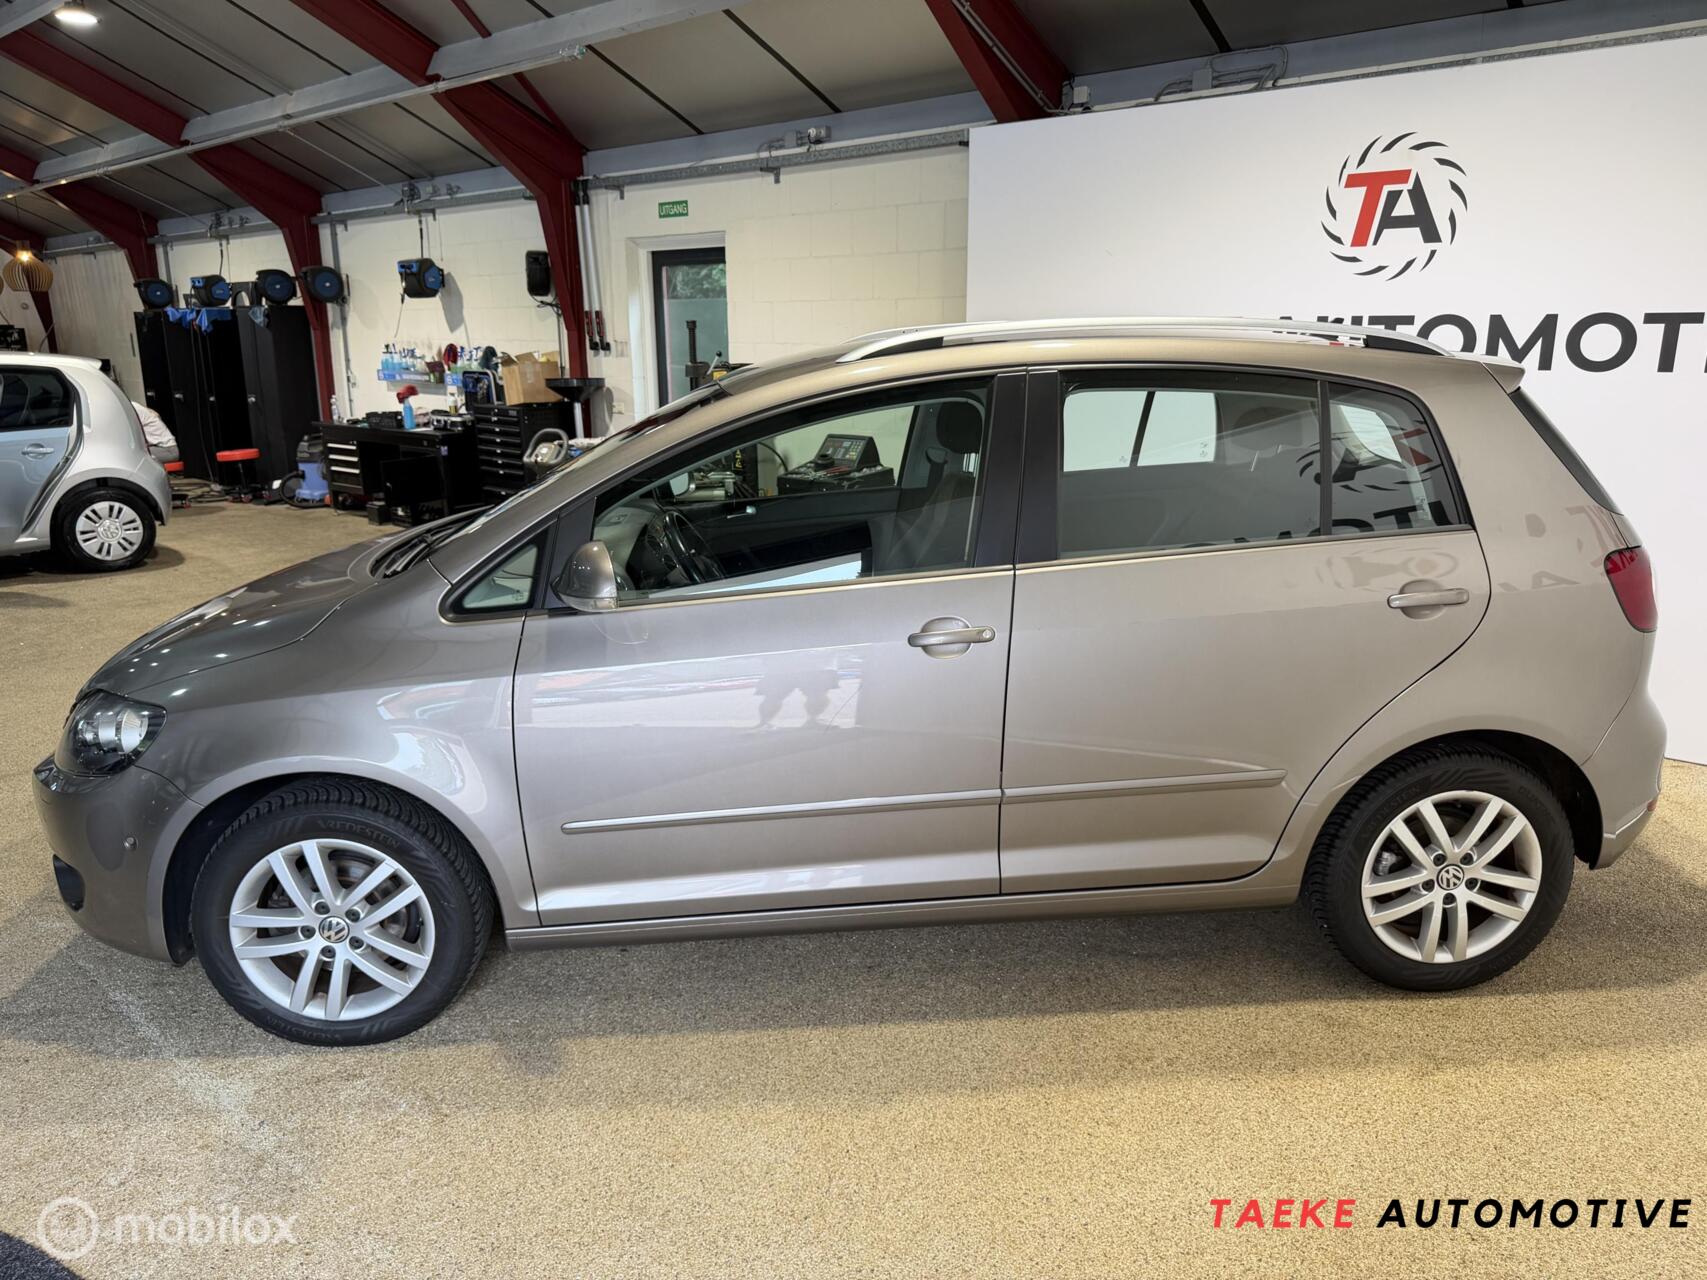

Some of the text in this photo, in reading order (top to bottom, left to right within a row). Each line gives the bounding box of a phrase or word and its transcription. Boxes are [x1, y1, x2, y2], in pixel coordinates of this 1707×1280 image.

[660, 203, 687, 216] UITGANG
[1343, 168, 1443, 248] TA
[1278, 311, 1707, 374] OMOT
